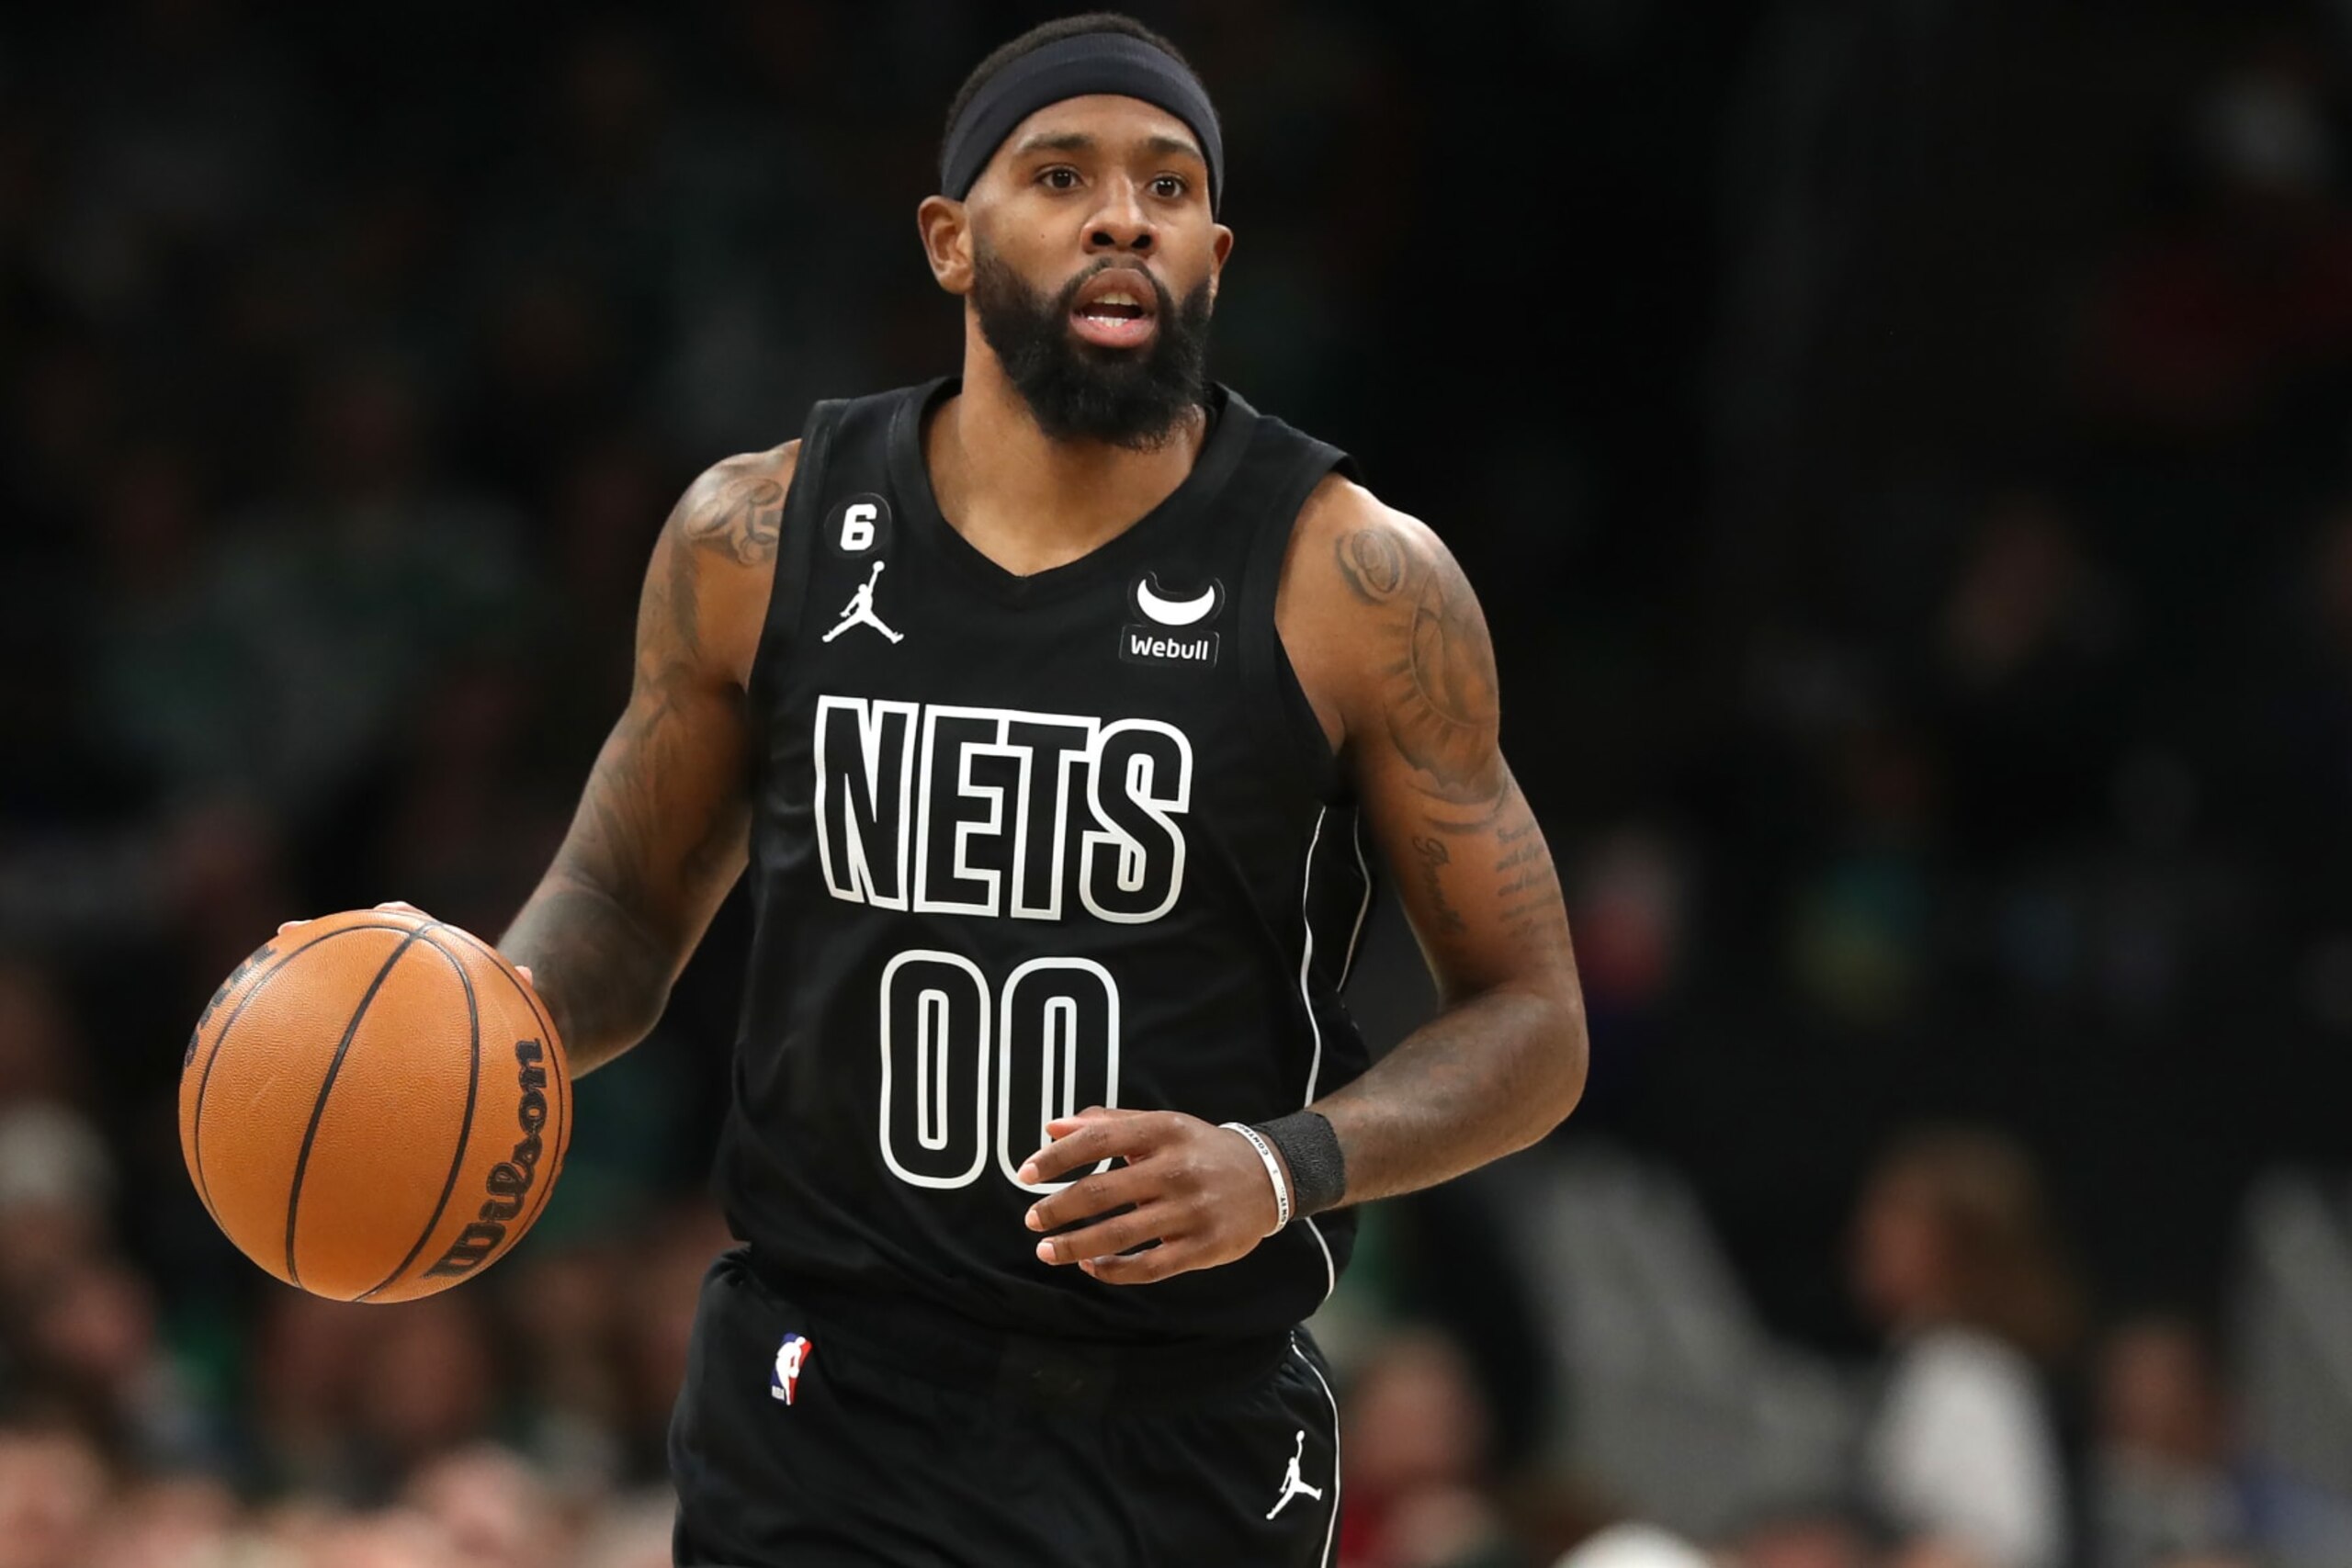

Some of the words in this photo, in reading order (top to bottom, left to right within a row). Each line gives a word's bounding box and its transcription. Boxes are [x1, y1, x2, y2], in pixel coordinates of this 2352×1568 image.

[840, 502, 877, 551] 6
[1131, 634, 1209, 660] Webull
[813, 694, 1193, 924] NETS
[420, 1037, 548, 1280] Wilson
[879, 949, 1120, 1194] 00
